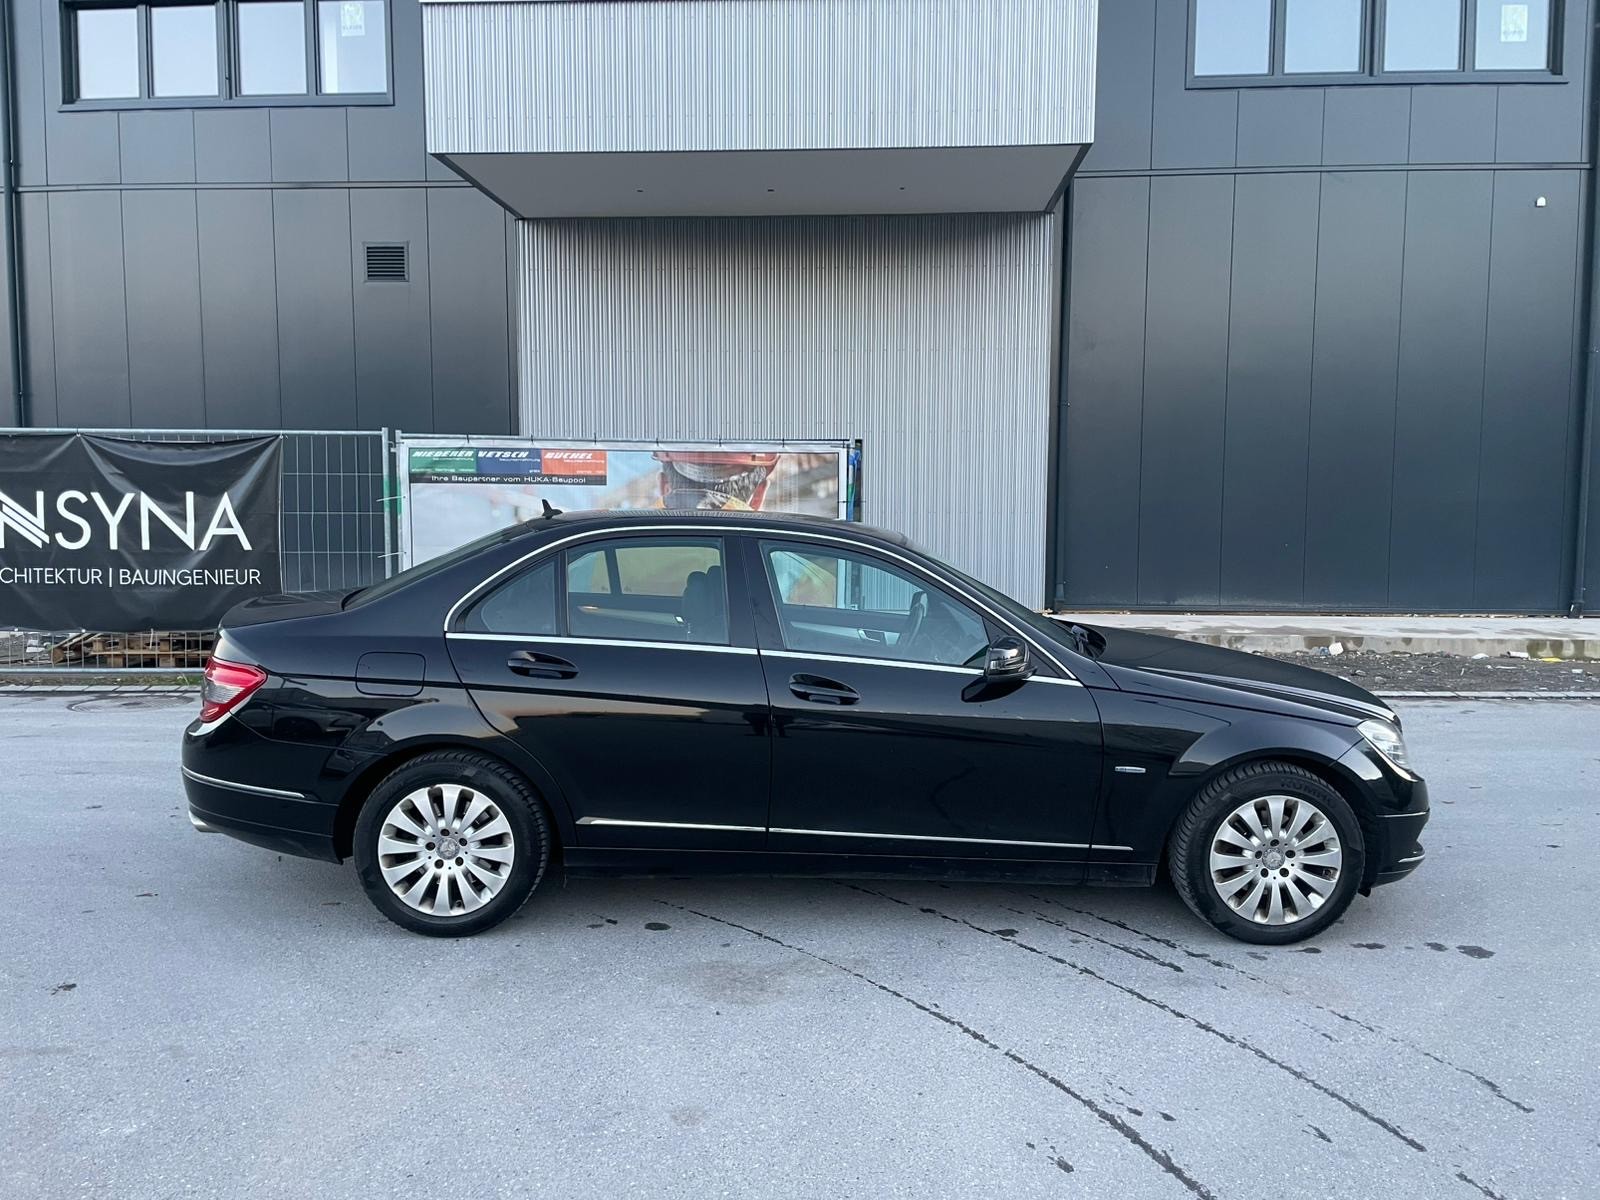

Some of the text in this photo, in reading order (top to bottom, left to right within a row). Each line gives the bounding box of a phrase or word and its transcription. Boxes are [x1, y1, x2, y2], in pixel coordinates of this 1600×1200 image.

[411, 450, 475, 458] NIEDERER
[477, 450, 529, 459] VETSCH
[451, 475, 501, 484] Baupartner
[0, 567, 103, 585] CHITEKTUR
[119, 568, 262, 586] BAUINGENIEUR
